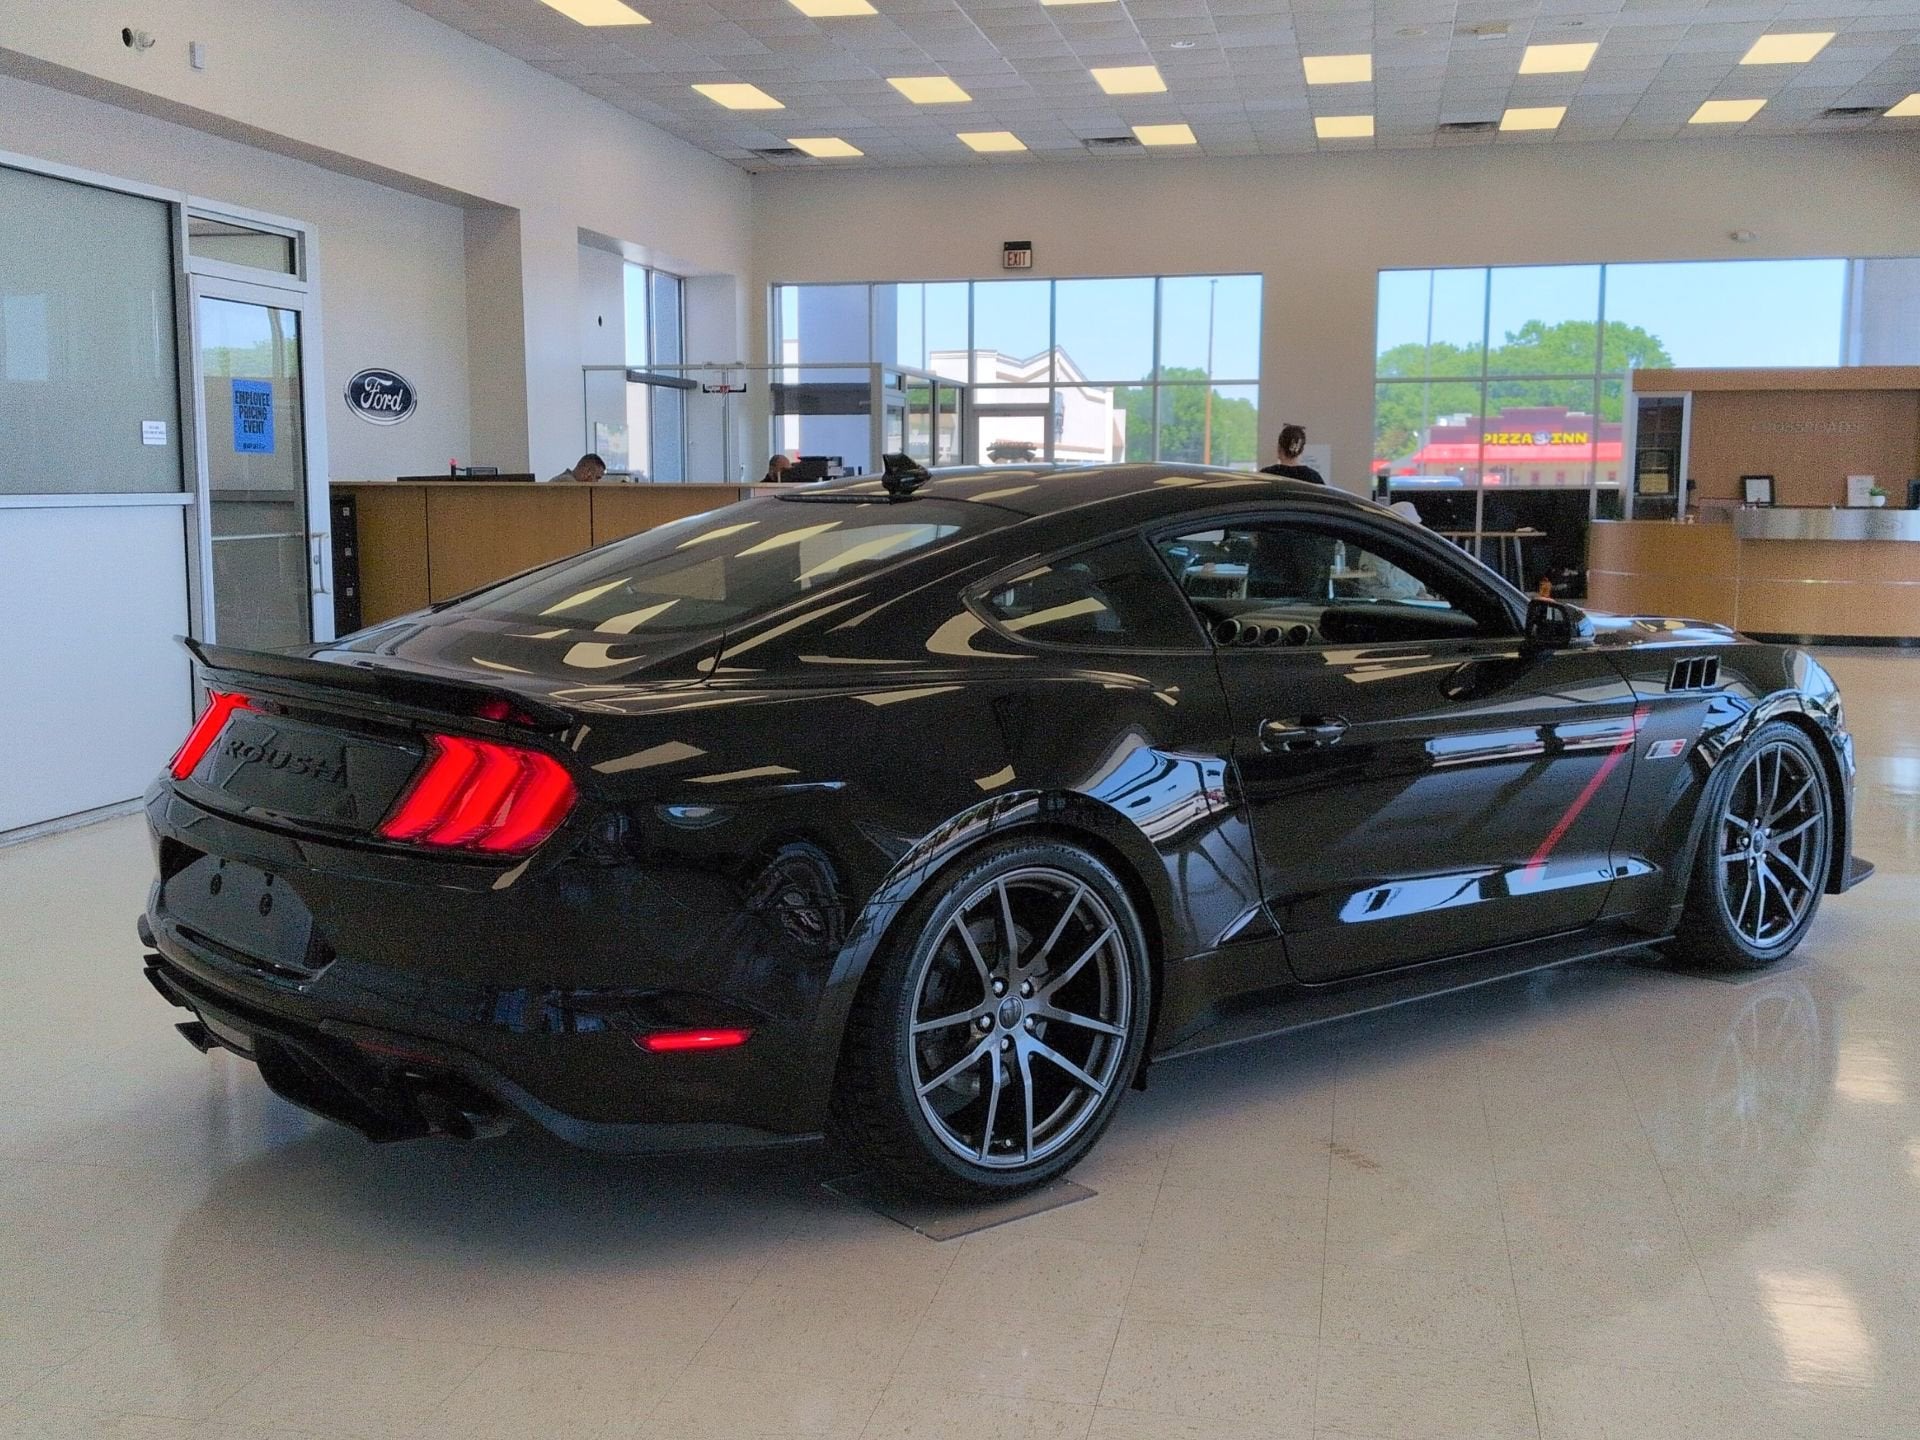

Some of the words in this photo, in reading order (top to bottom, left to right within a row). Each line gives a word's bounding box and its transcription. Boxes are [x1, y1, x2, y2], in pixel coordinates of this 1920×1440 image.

[1007, 251, 1027, 266] EXIT
[234, 390, 270, 407] EMPLOYEE
[360, 376, 403, 411] Ford
[238, 405, 268, 421] PRICING
[243, 419, 265, 434] EVENT
[1483, 432, 1533, 446] PIZZA
[1551, 432, 1589, 446] INN
[225, 739, 344, 784] ROUSH
